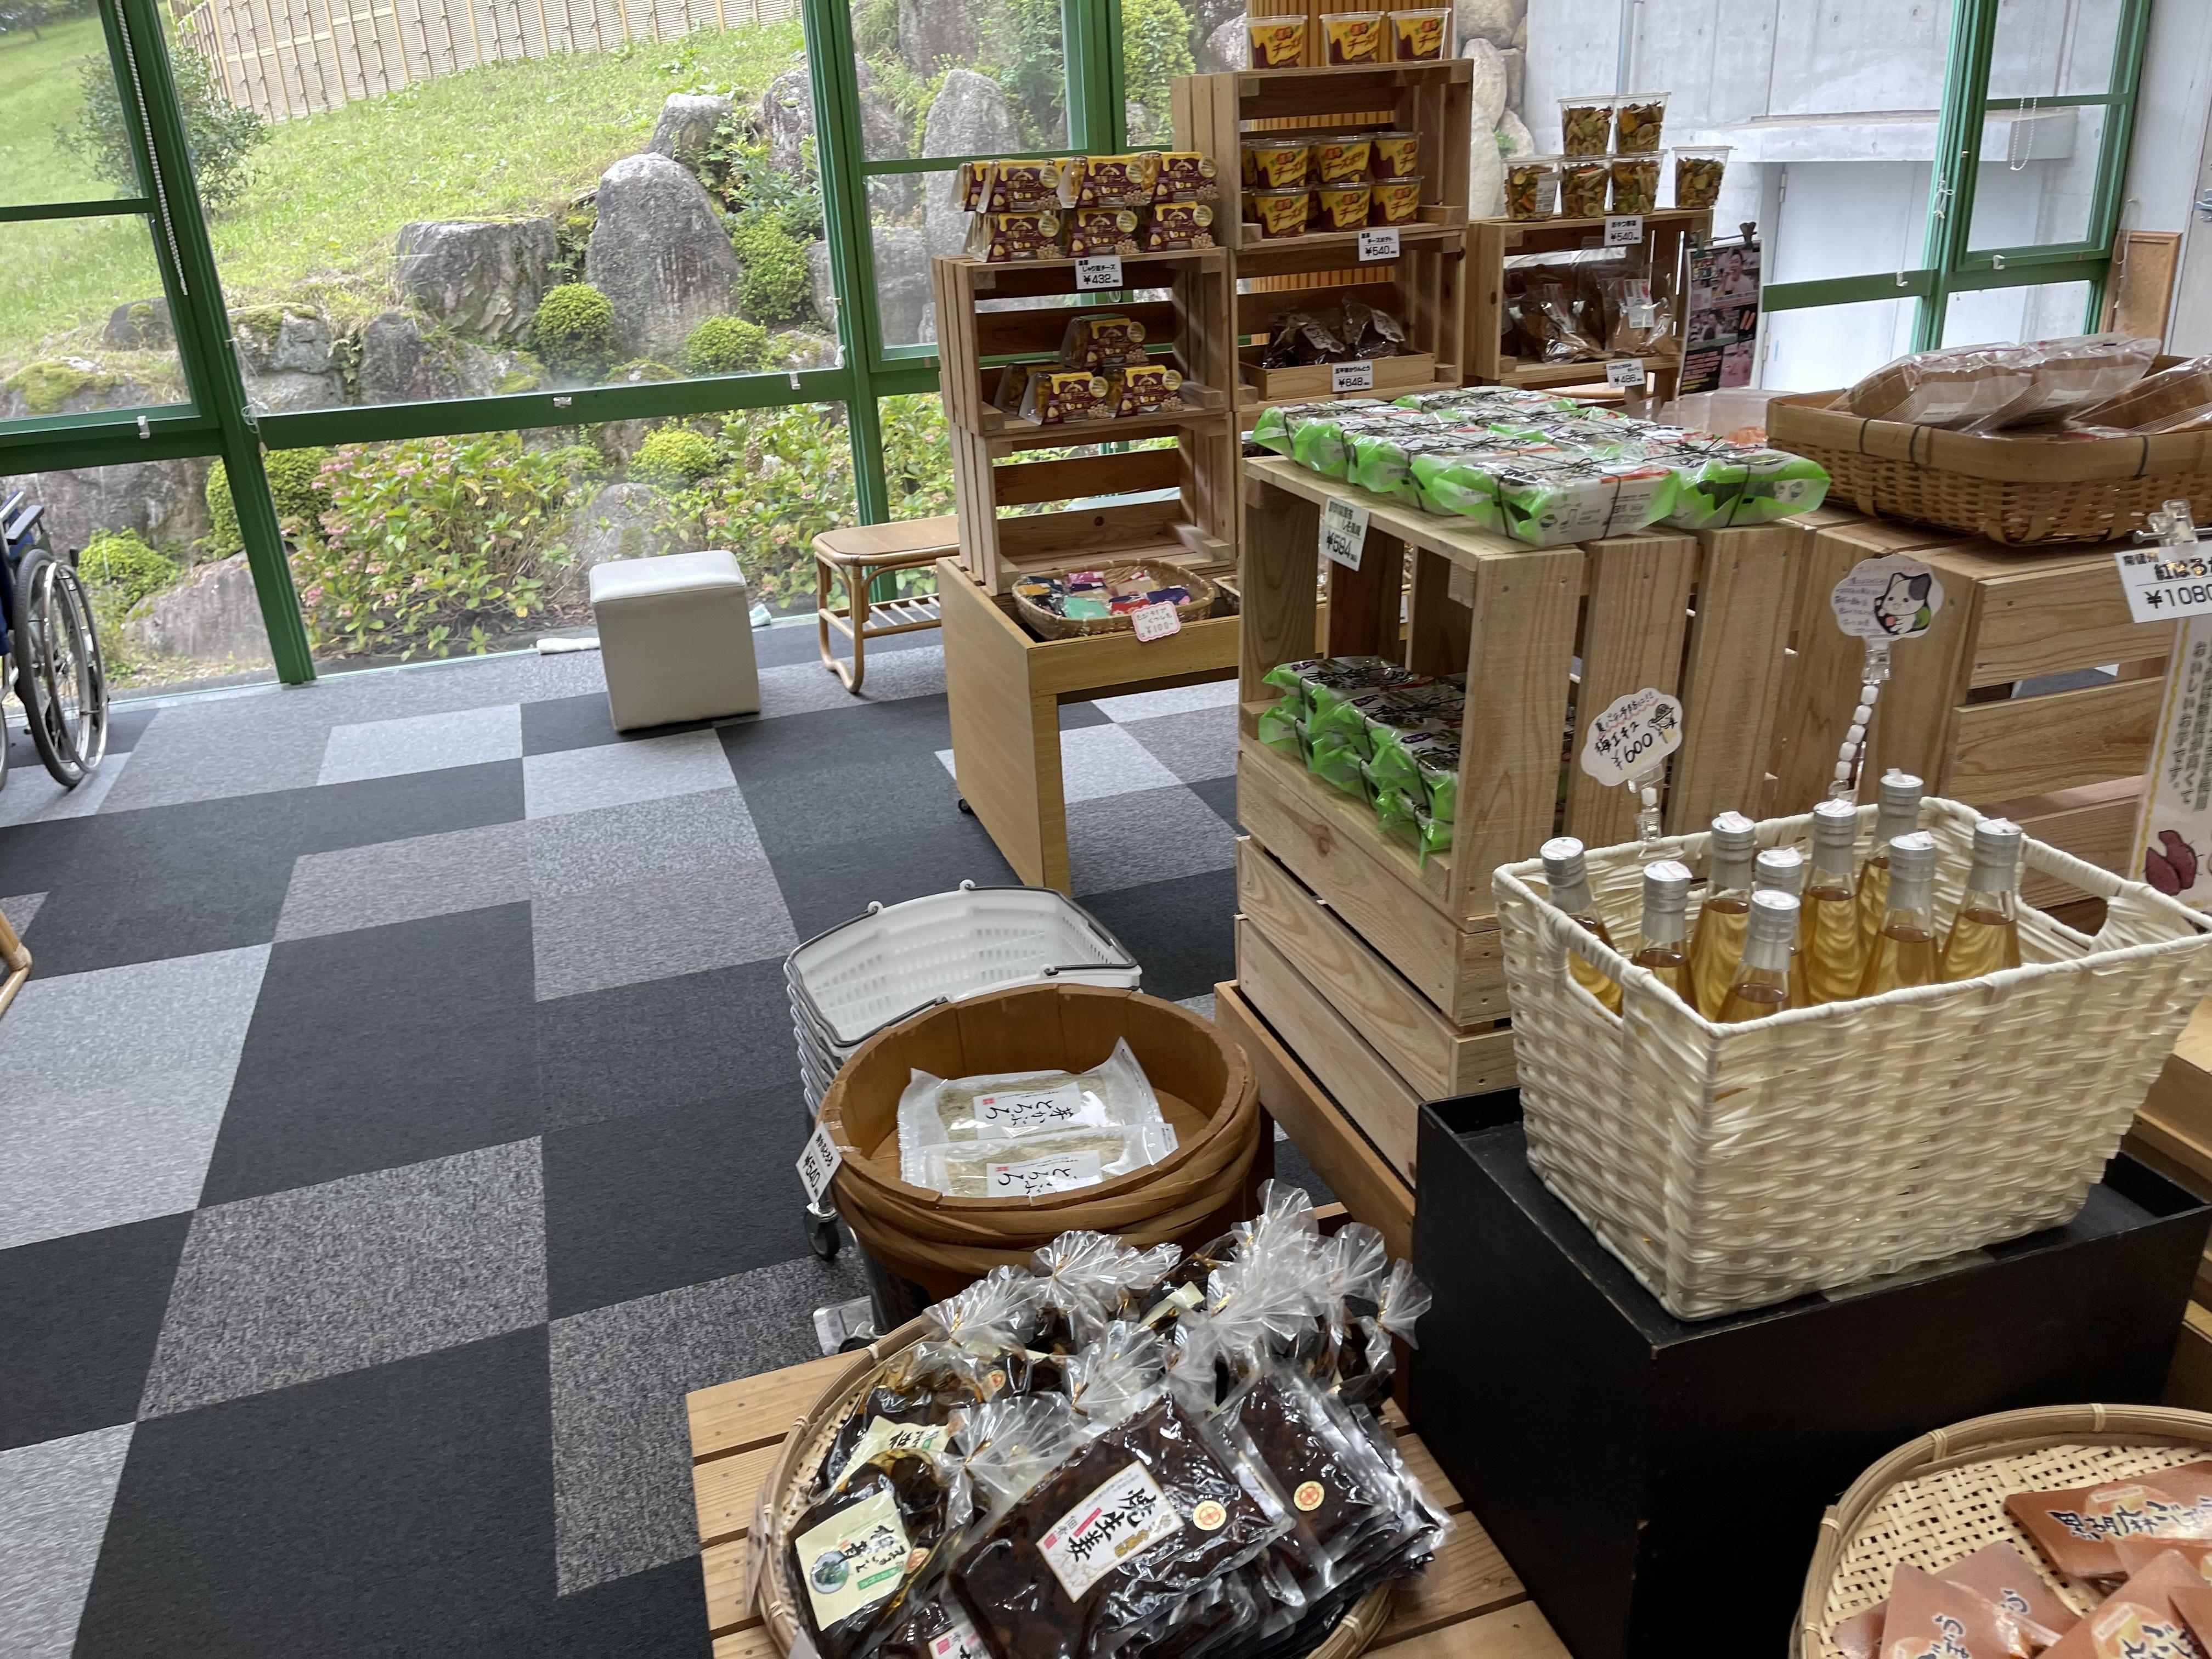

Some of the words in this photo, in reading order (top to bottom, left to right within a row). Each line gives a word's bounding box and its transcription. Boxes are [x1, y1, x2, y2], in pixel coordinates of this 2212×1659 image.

[1365, 245, 1389, 256] ¥540
[1083, 274, 1111, 285] ¥432
[2153, 556, 2212, 581] 紅はる
[802, 1150, 820, 1188] ¥540
